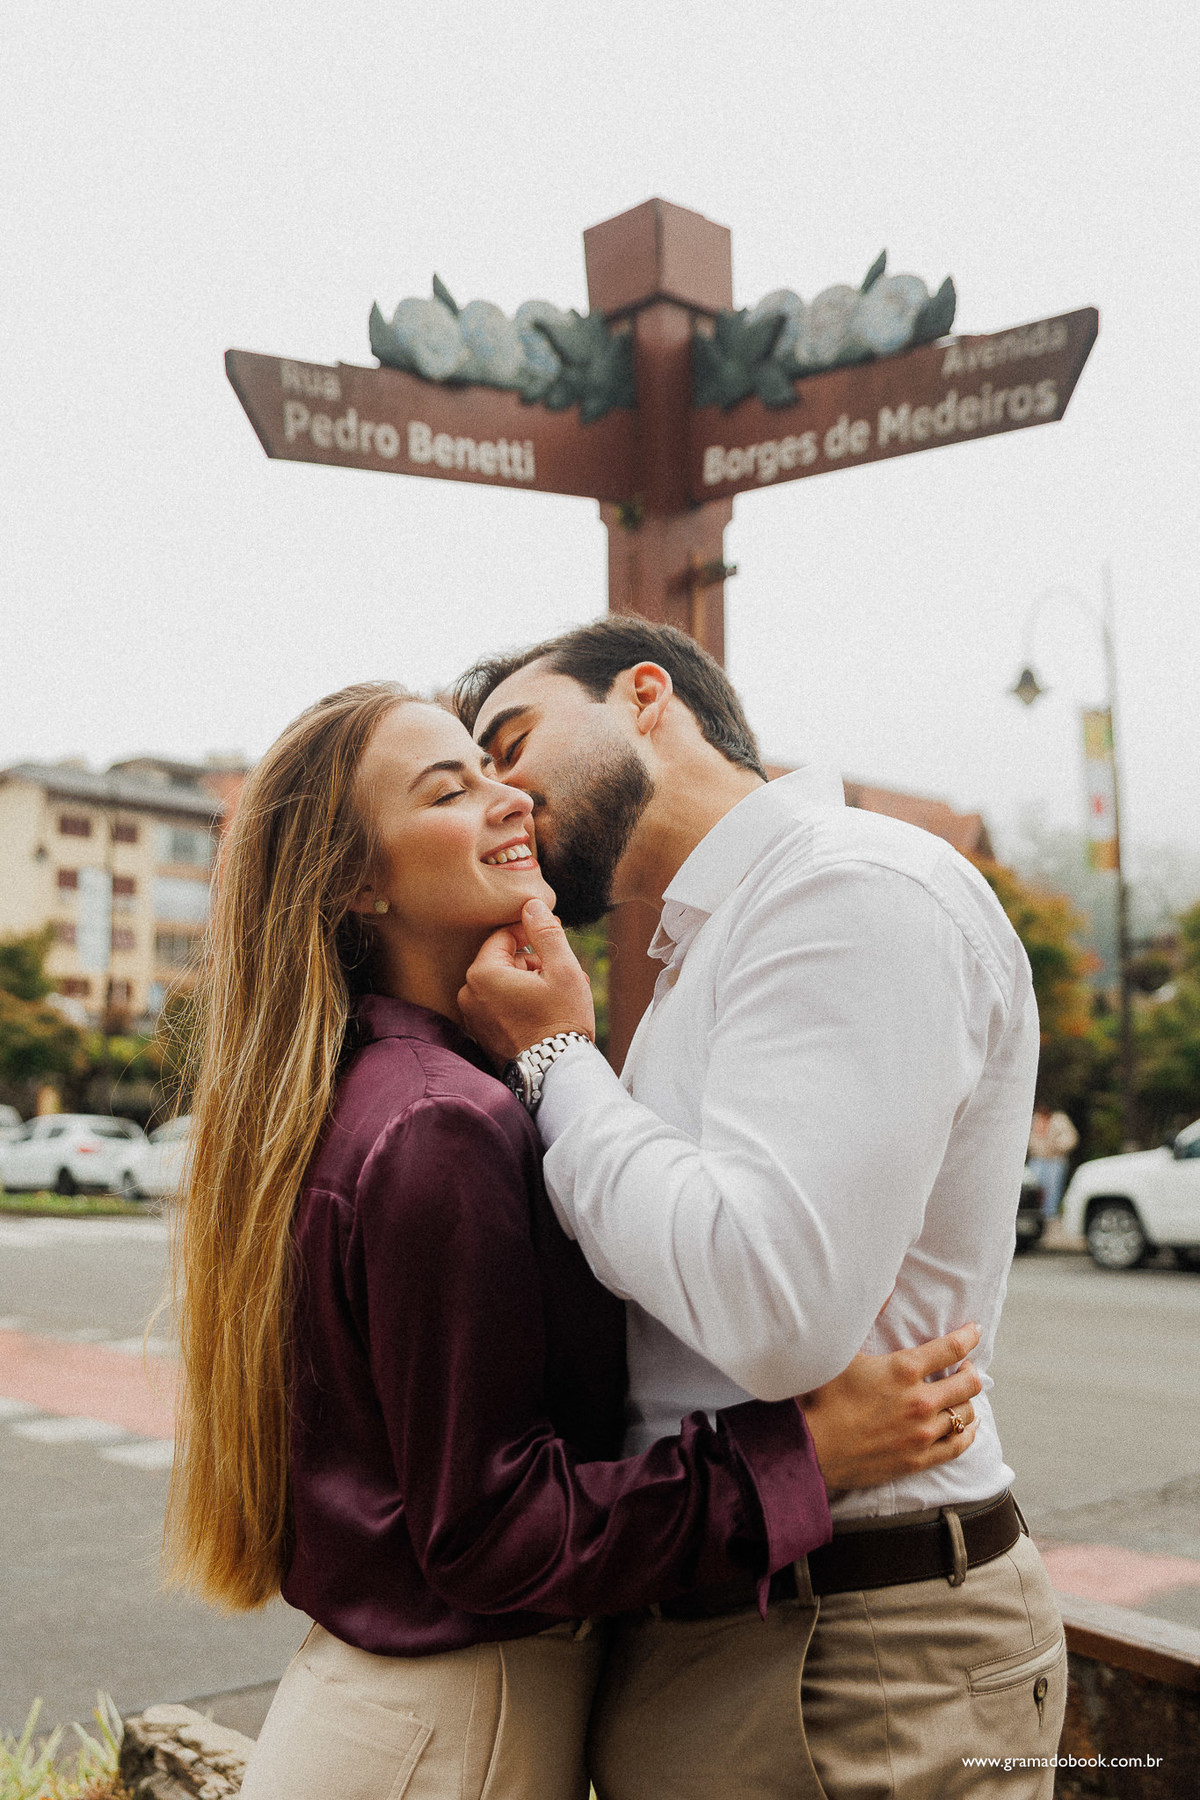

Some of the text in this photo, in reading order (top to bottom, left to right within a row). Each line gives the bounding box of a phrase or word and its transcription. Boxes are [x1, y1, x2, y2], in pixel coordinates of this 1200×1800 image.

[282, 360, 341, 398] Rua
[943, 320, 1069, 377] Avenida
[284, 402, 535, 480] Pedro Benetti
[703, 379, 1057, 484] Borges de Medeiros
